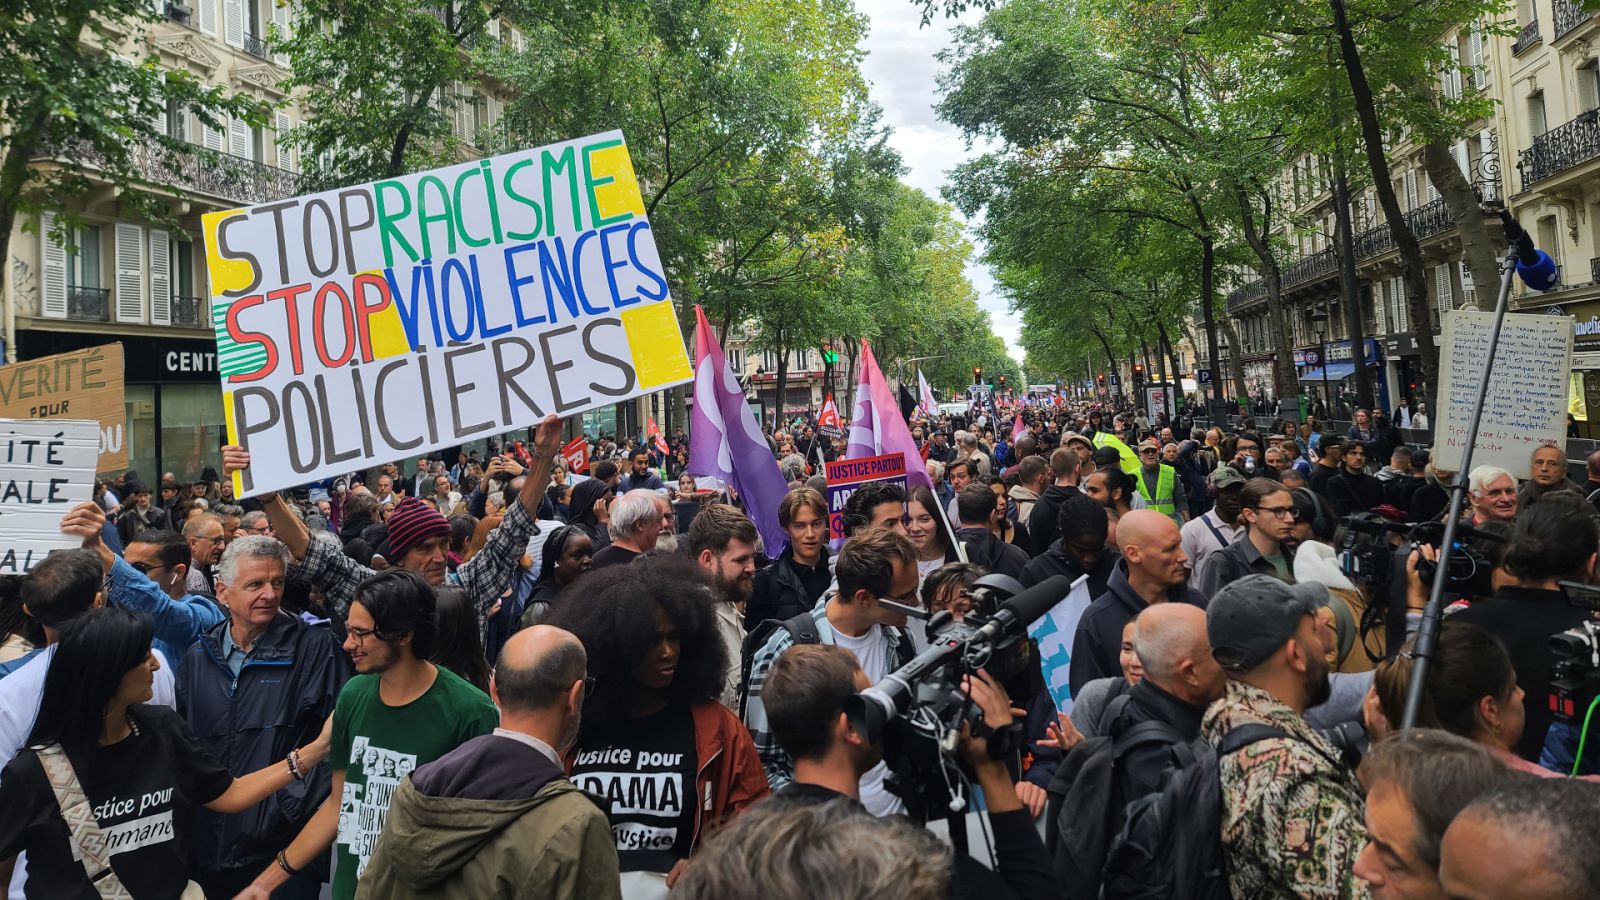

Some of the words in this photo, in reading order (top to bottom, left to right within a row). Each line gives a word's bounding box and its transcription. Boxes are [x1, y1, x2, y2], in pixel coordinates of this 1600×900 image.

[218, 189, 374, 297] STOP
[374, 139, 633, 267] RACISME
[226, 273, 392, 383] STOP
[385, 221, 668, 352] VIOLENCES
[166, 351, 219, 371] CENT
[30, 400, 70, 418] POUR
[234, 319, 636, 492] POLICIÈRES
[1447, 438, 1503, 451] Niezsche
[829, 461, 870, 480] JUSTICE
[871, 456, 905, 475] PARTOUT
[0, 478, 69, 504] ALE
[636, 751, 683, 771] pour
[93, 796, 136, 821] stice
[138, 787, 174, 817] pour
[572, 776, 680, 812] DAMA
[102, 819, 172, 850] hmane
